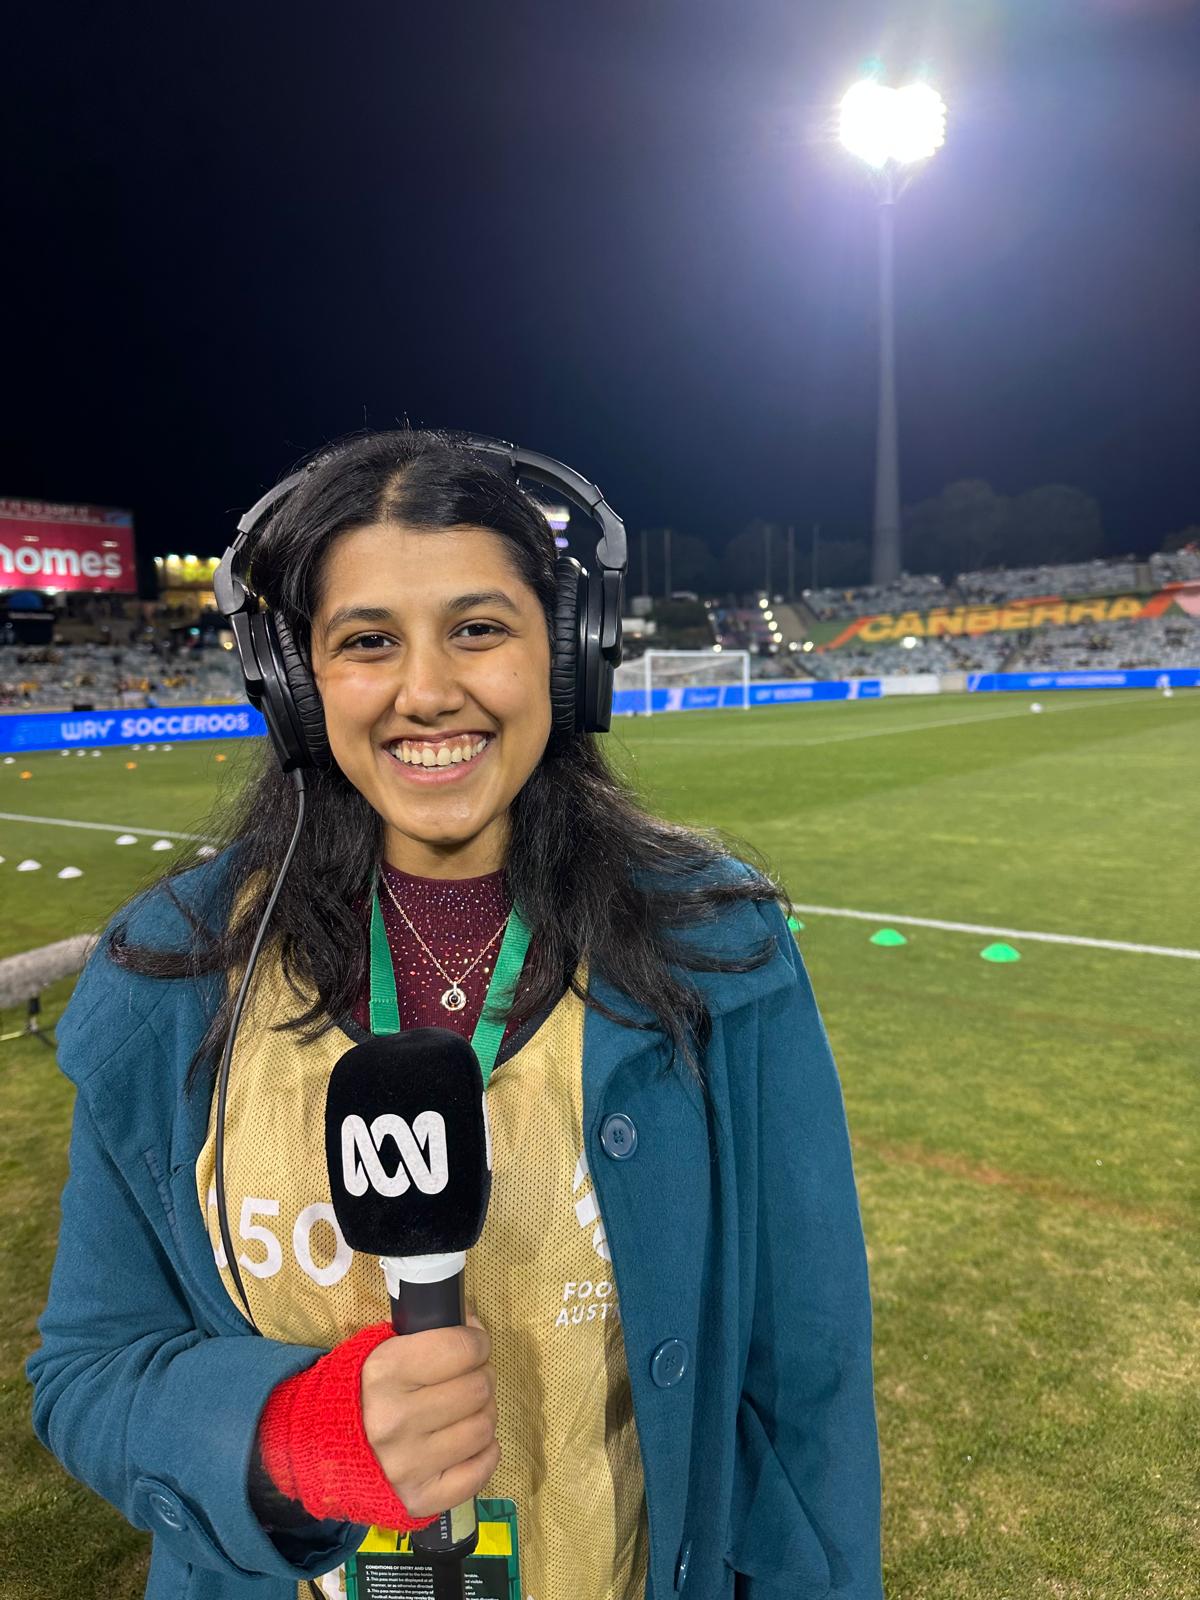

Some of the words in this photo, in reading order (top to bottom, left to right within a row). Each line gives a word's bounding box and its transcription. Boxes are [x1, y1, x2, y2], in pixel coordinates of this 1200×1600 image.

[857, 597, 1144, 642] CANBERRA
[562, 1280, 612, 1301] FOO
[554, 1303, 619, 1327] AUST
